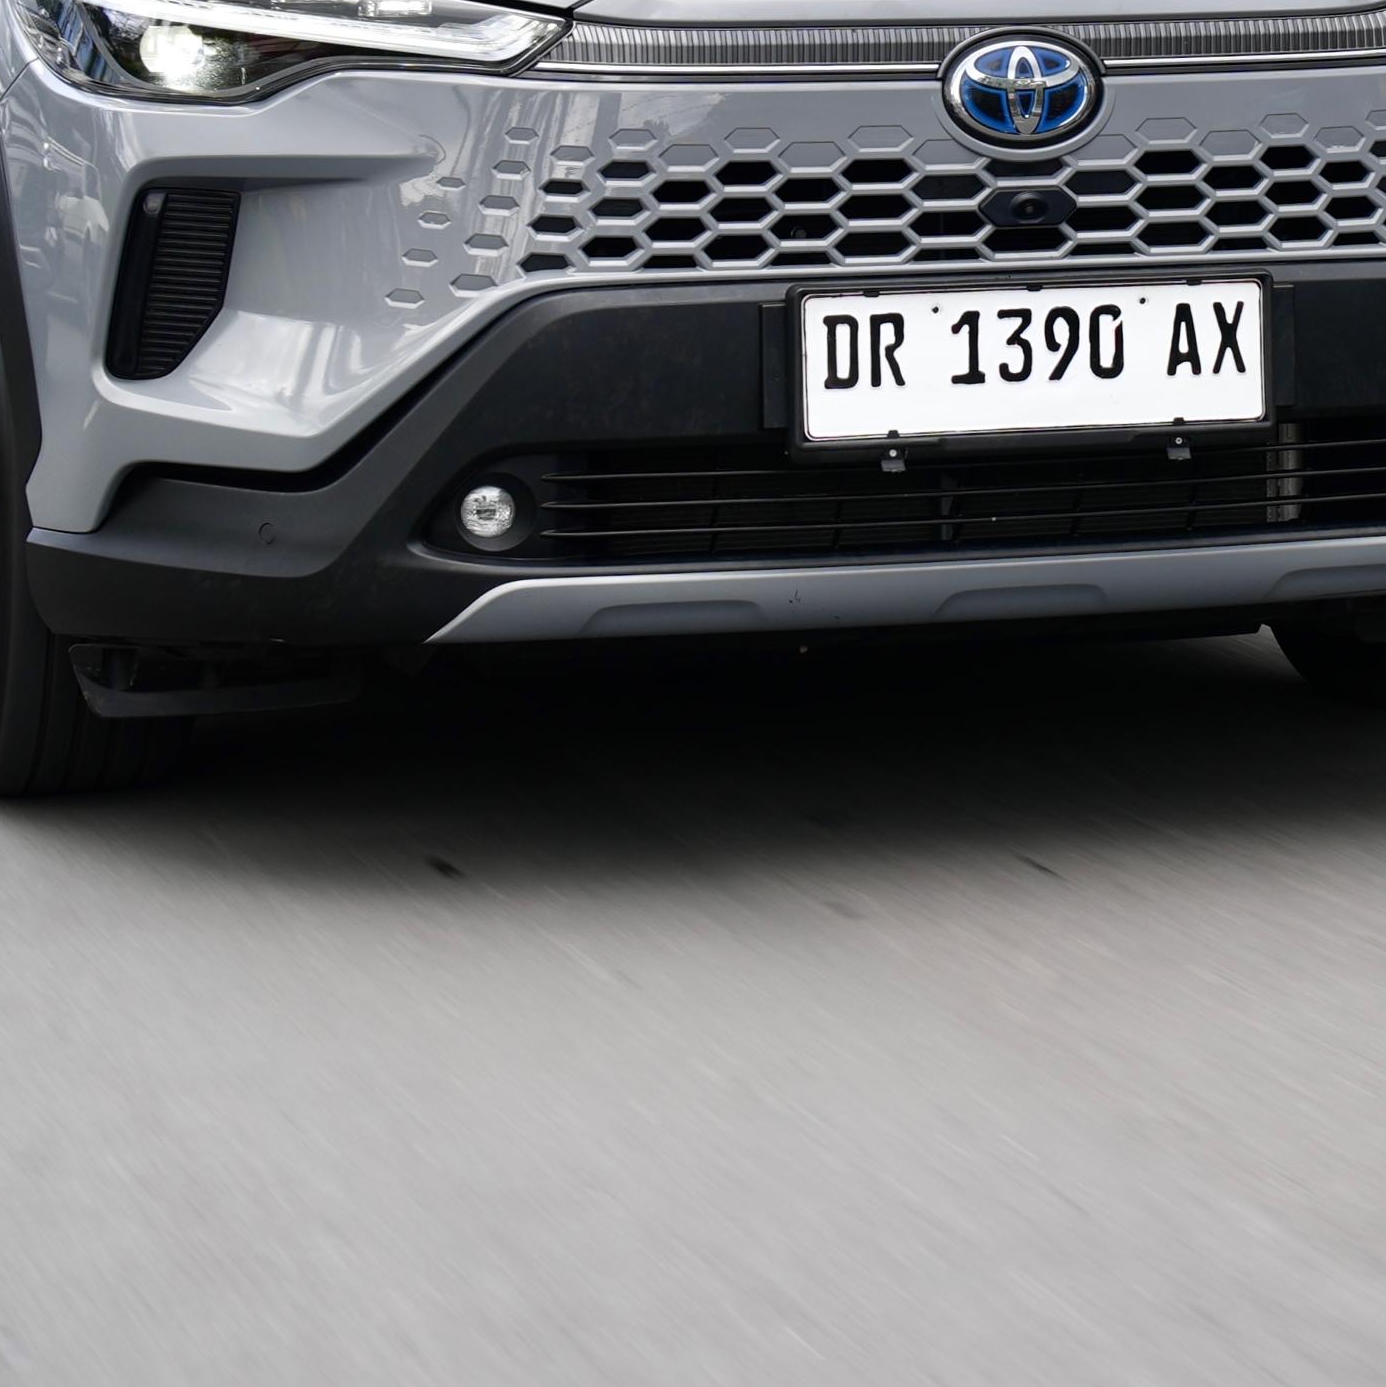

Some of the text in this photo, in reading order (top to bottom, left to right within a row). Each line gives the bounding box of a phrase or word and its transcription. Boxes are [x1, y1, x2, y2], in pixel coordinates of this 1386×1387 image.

[823, 300, 1247, 390] DR 1390 AX
